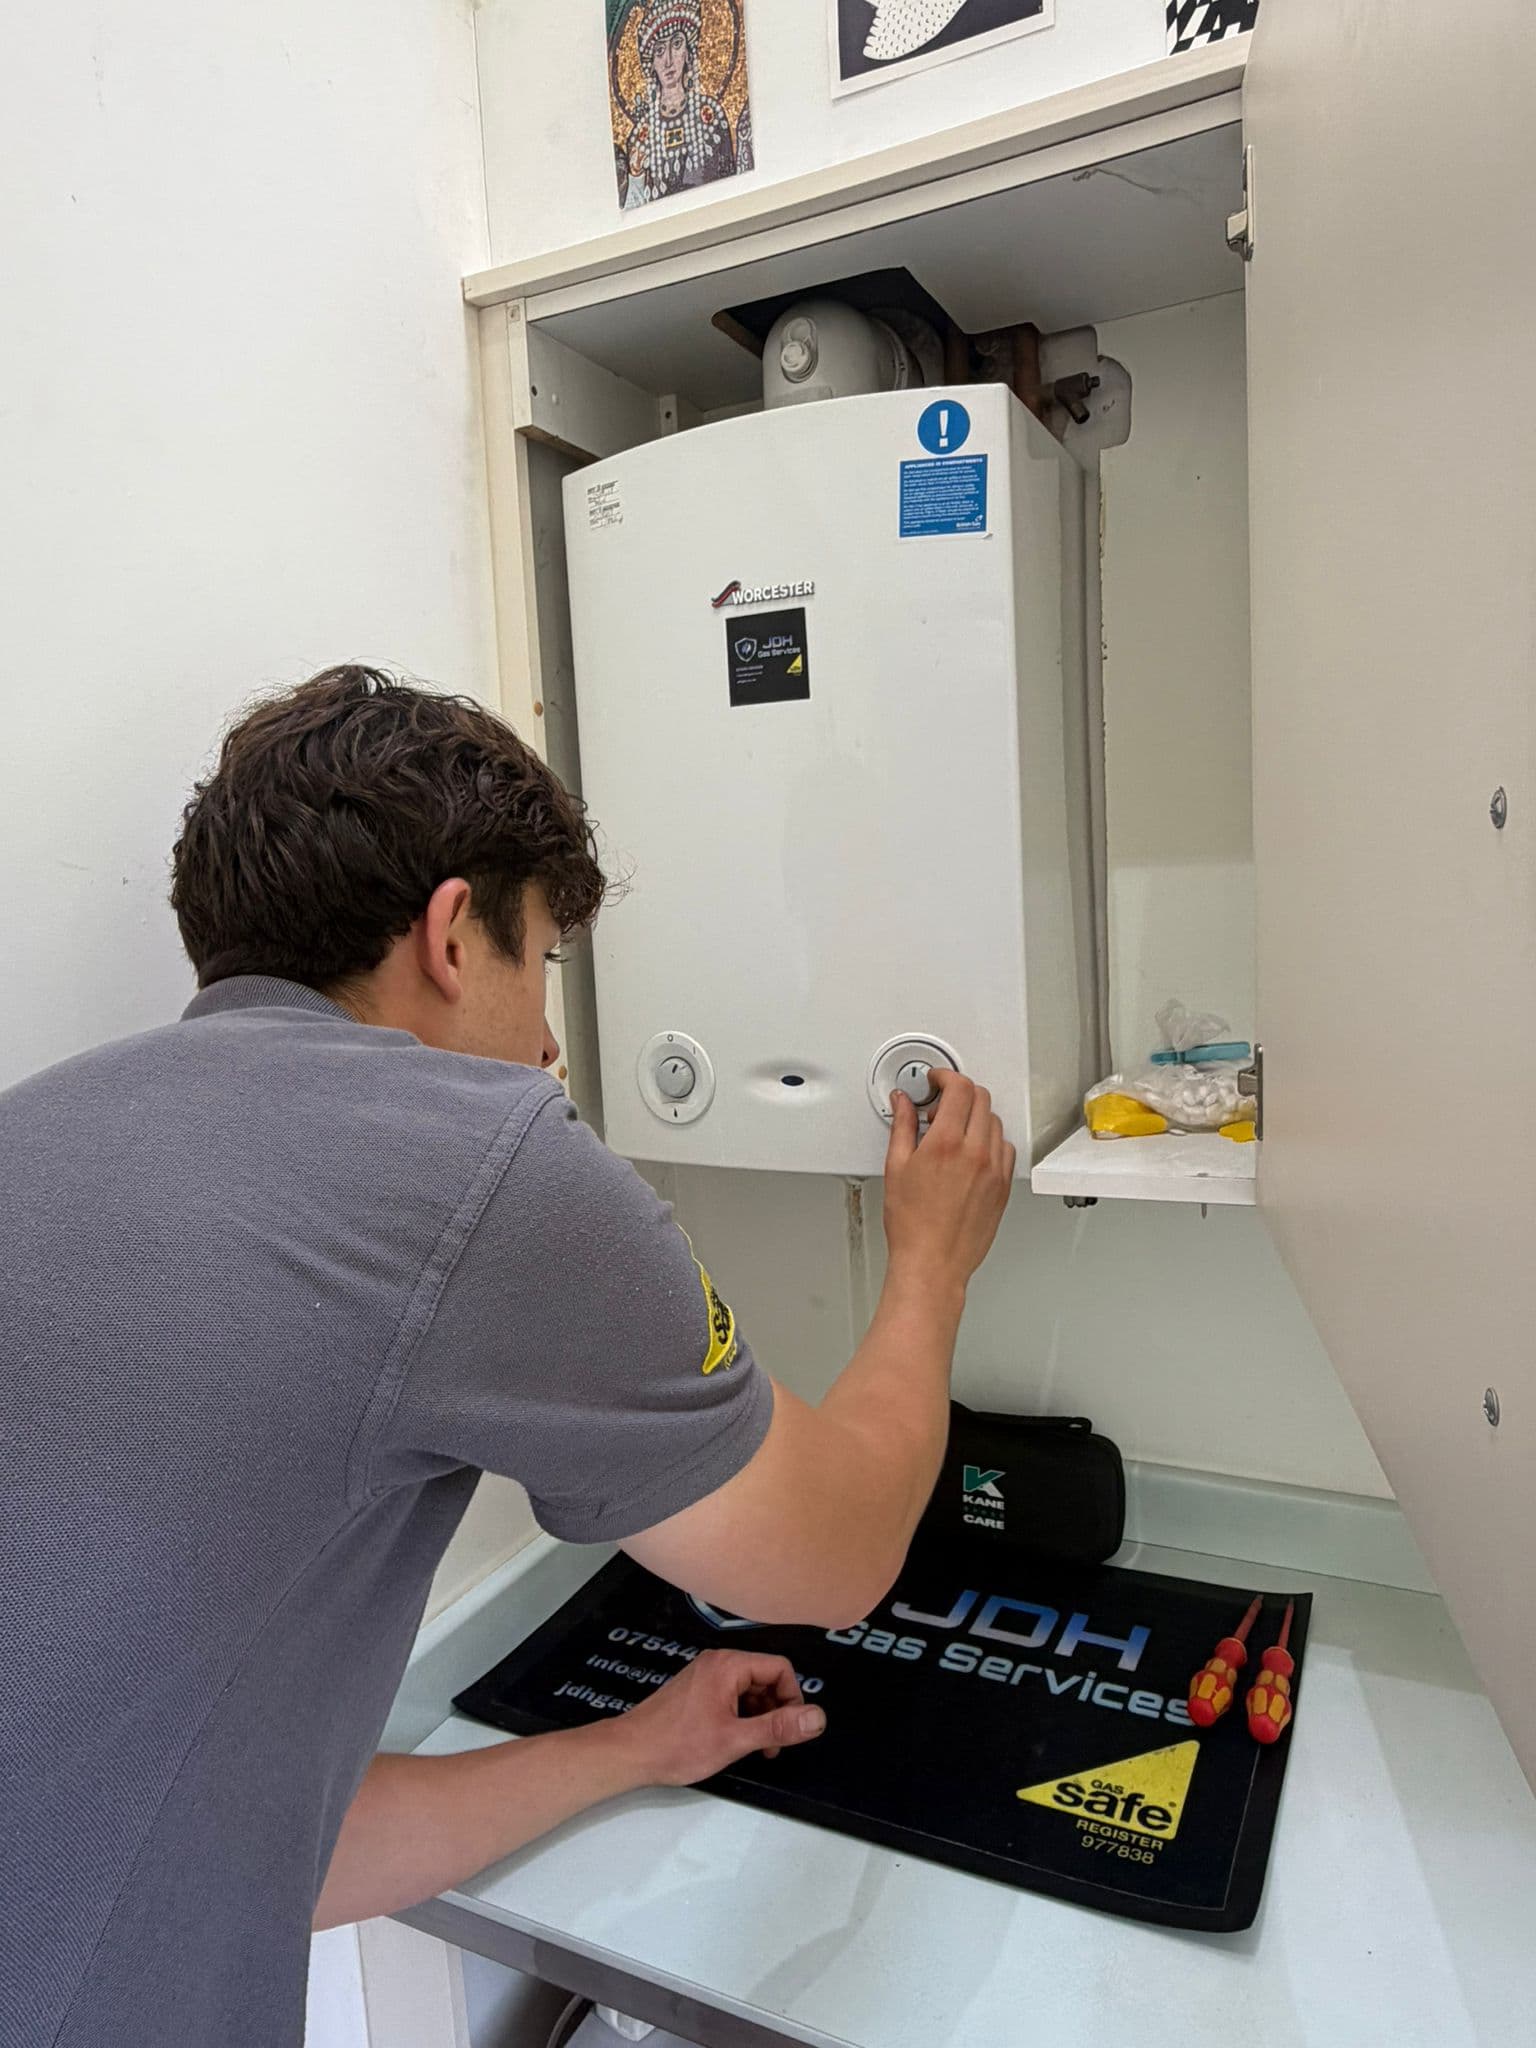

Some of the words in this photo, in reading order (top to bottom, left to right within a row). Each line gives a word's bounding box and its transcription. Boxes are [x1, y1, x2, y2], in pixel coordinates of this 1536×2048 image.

[731, 581, 815, 605] WORCESTER
[762, 635, 793, 649] JDH
[962, 1494, 1005, 1510] KANE
[962, 1514, 1005, 1530] CARE
[890, 1589, 1152, 1673] JDH
[825, 1621, 928, 1661] Gas
[938, 1642, 1196, 1727] Services
[1090, 1779, 1124, 1795] GAS
[1052, 1782, 1173, 1831] safe
[1076, 1819, 1164, 1851] REGISTER
[1081, 1835, 1155, 1865] 977838
